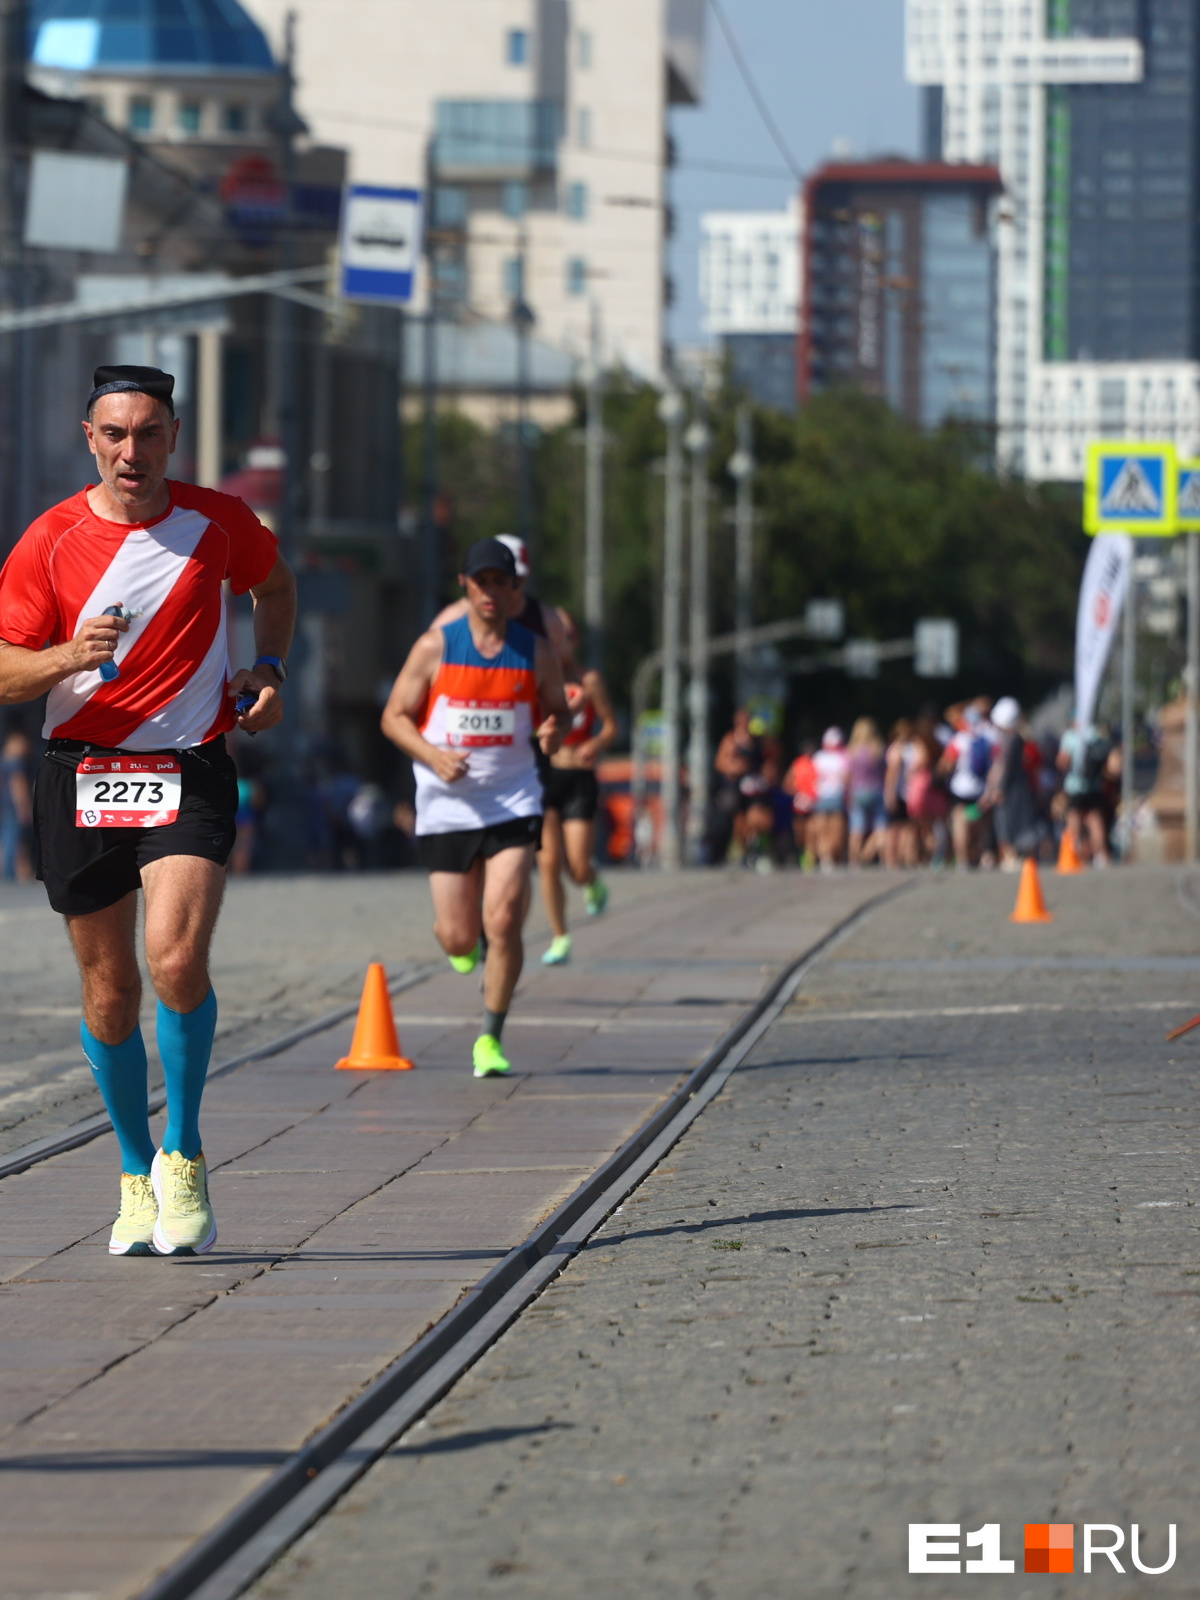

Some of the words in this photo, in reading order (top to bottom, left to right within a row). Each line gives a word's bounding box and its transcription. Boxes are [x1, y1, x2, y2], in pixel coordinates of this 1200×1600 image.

[458, 714, 502, 730] 2013
[94, 781, 164, 804] 2273
[84, 809, 98, 824] B
